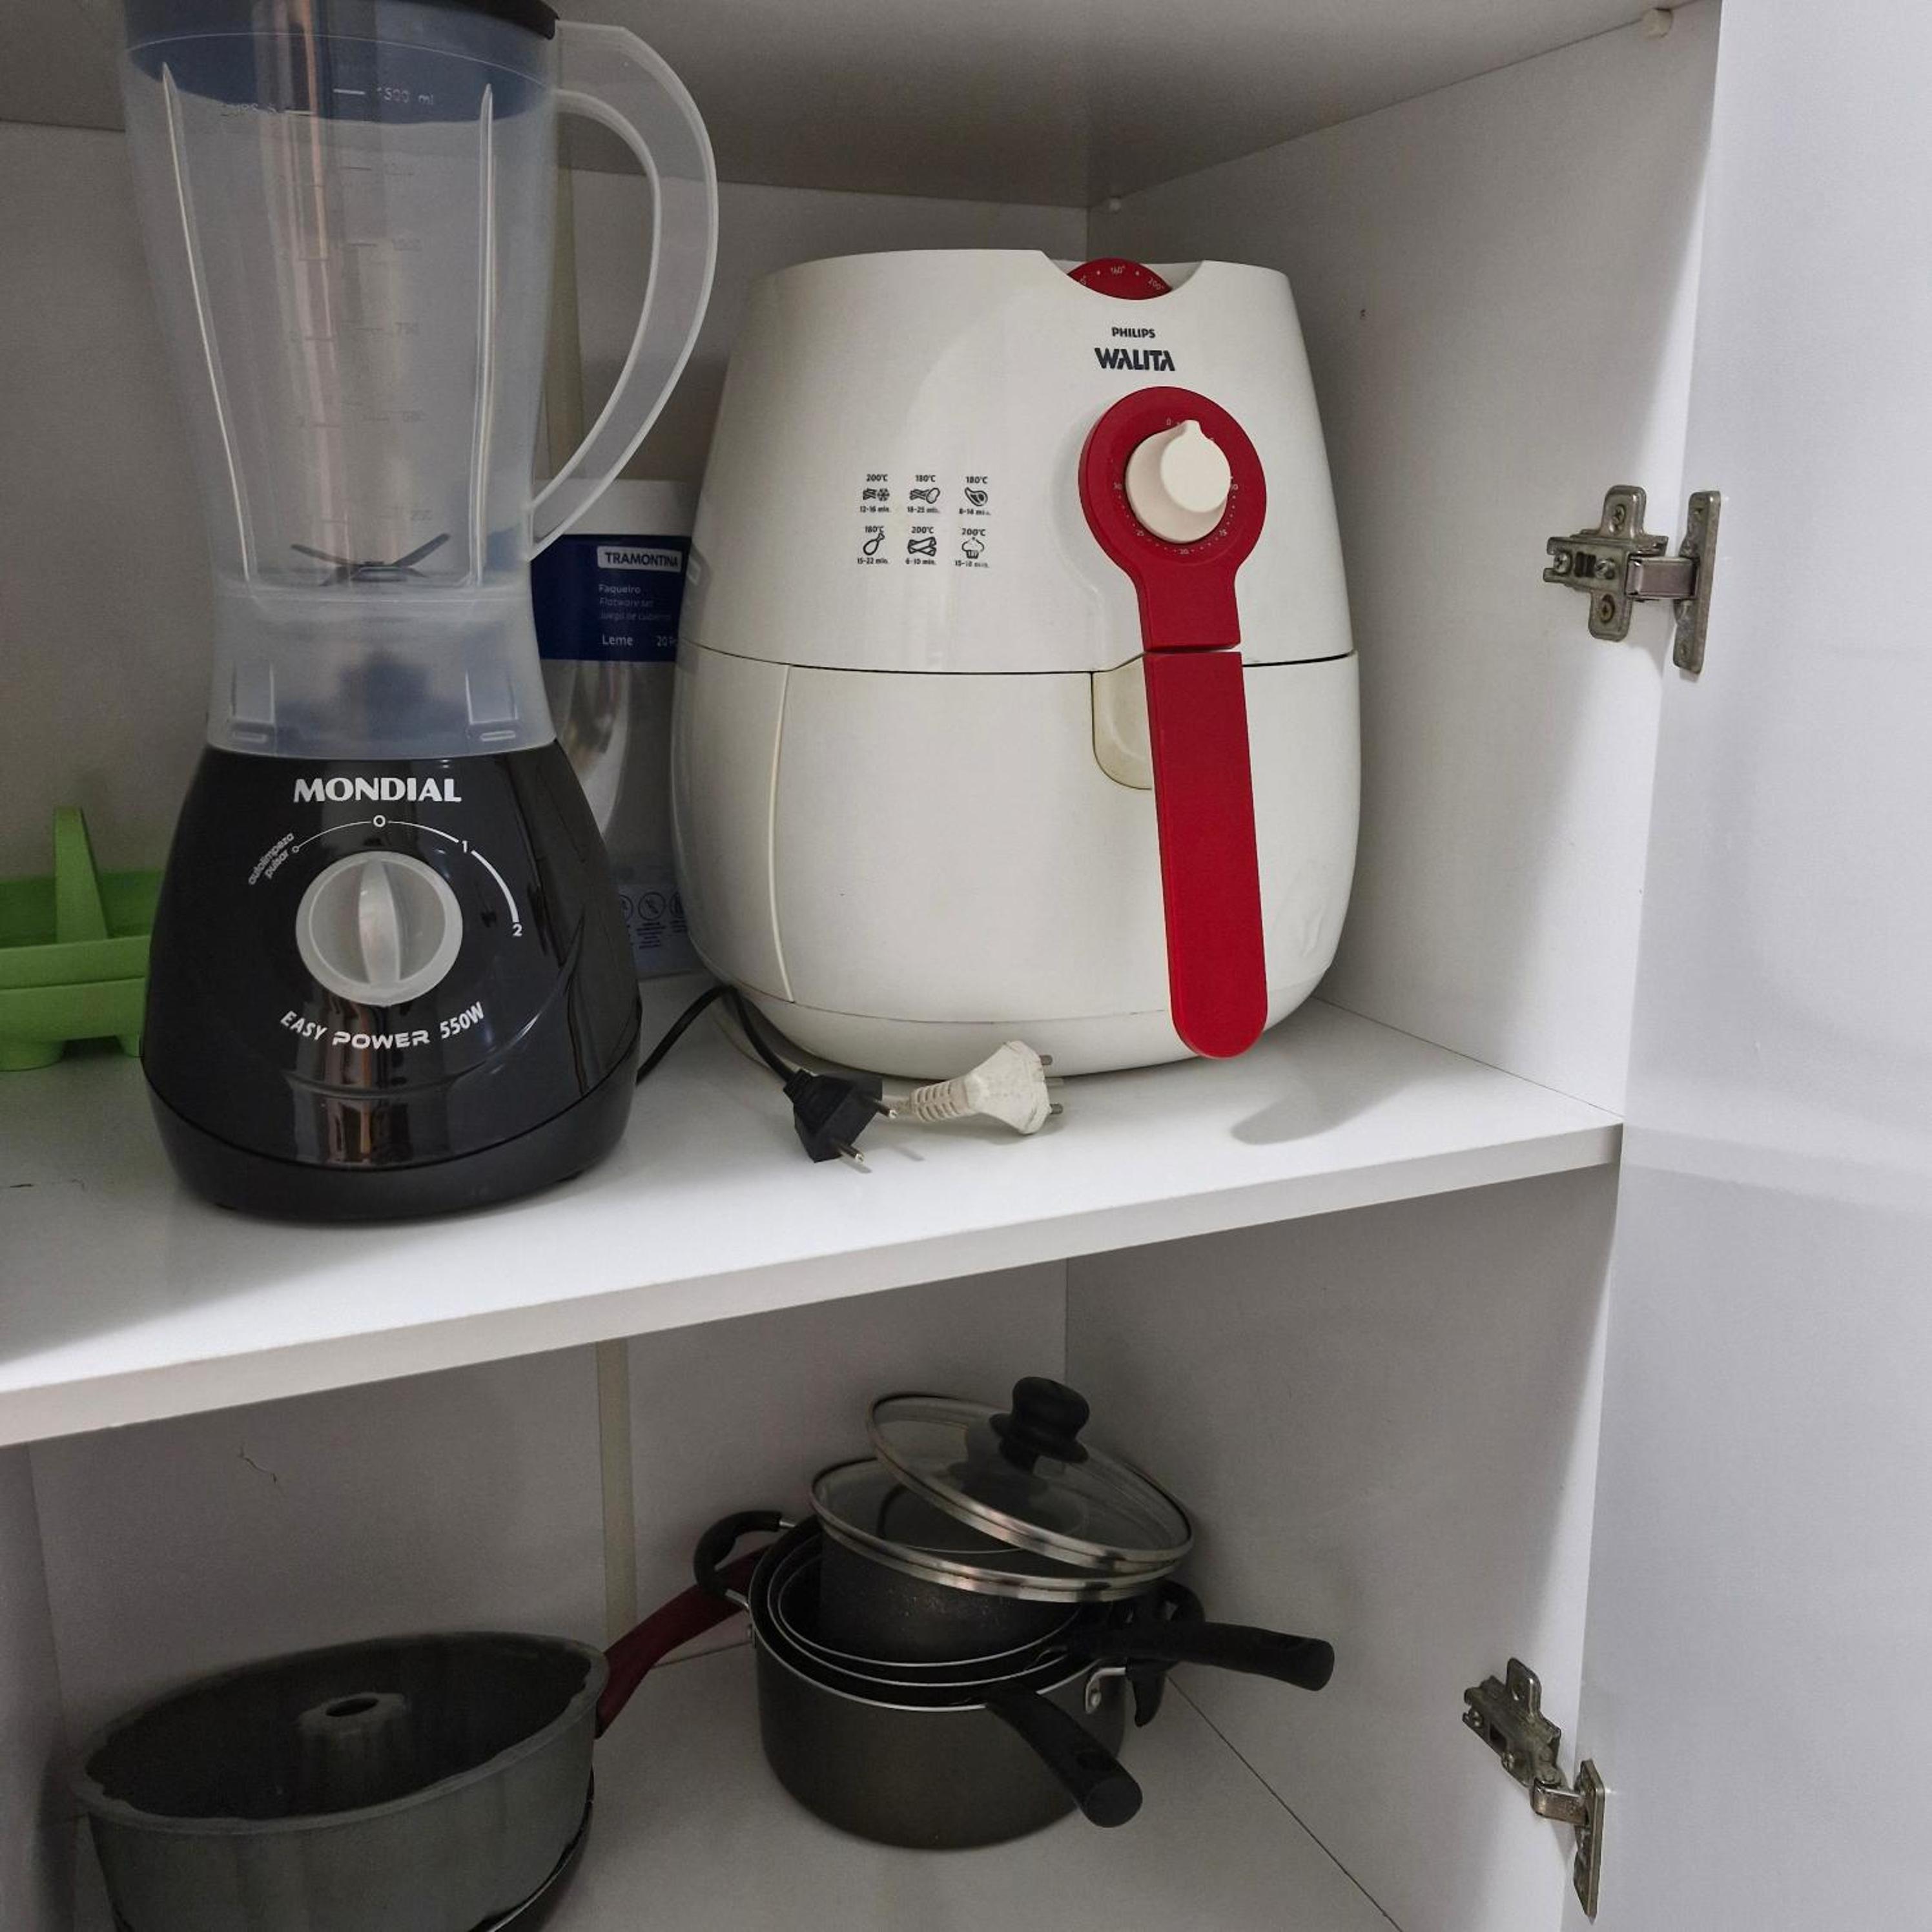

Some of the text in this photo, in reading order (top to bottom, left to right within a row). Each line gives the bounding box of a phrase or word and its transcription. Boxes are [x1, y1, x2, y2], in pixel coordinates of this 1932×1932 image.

[1112, 327, 1156, 338] PHILIPS
[1094, 347, 1175, 371] WALITA
[604, 552, 678, 567] TRAMONTINA
[599, 584, 641, 595] Faqueiro
[602, 633, 633, 646] Leme
[293, 777, 462, 803] MONDIAL
[460, 841, 469, 854] 1
[265, 849, 289, 880] pulsar
[512, 924, 522, 936] 2
[280, 1001, 484, 1049] EASY POWER 550W
